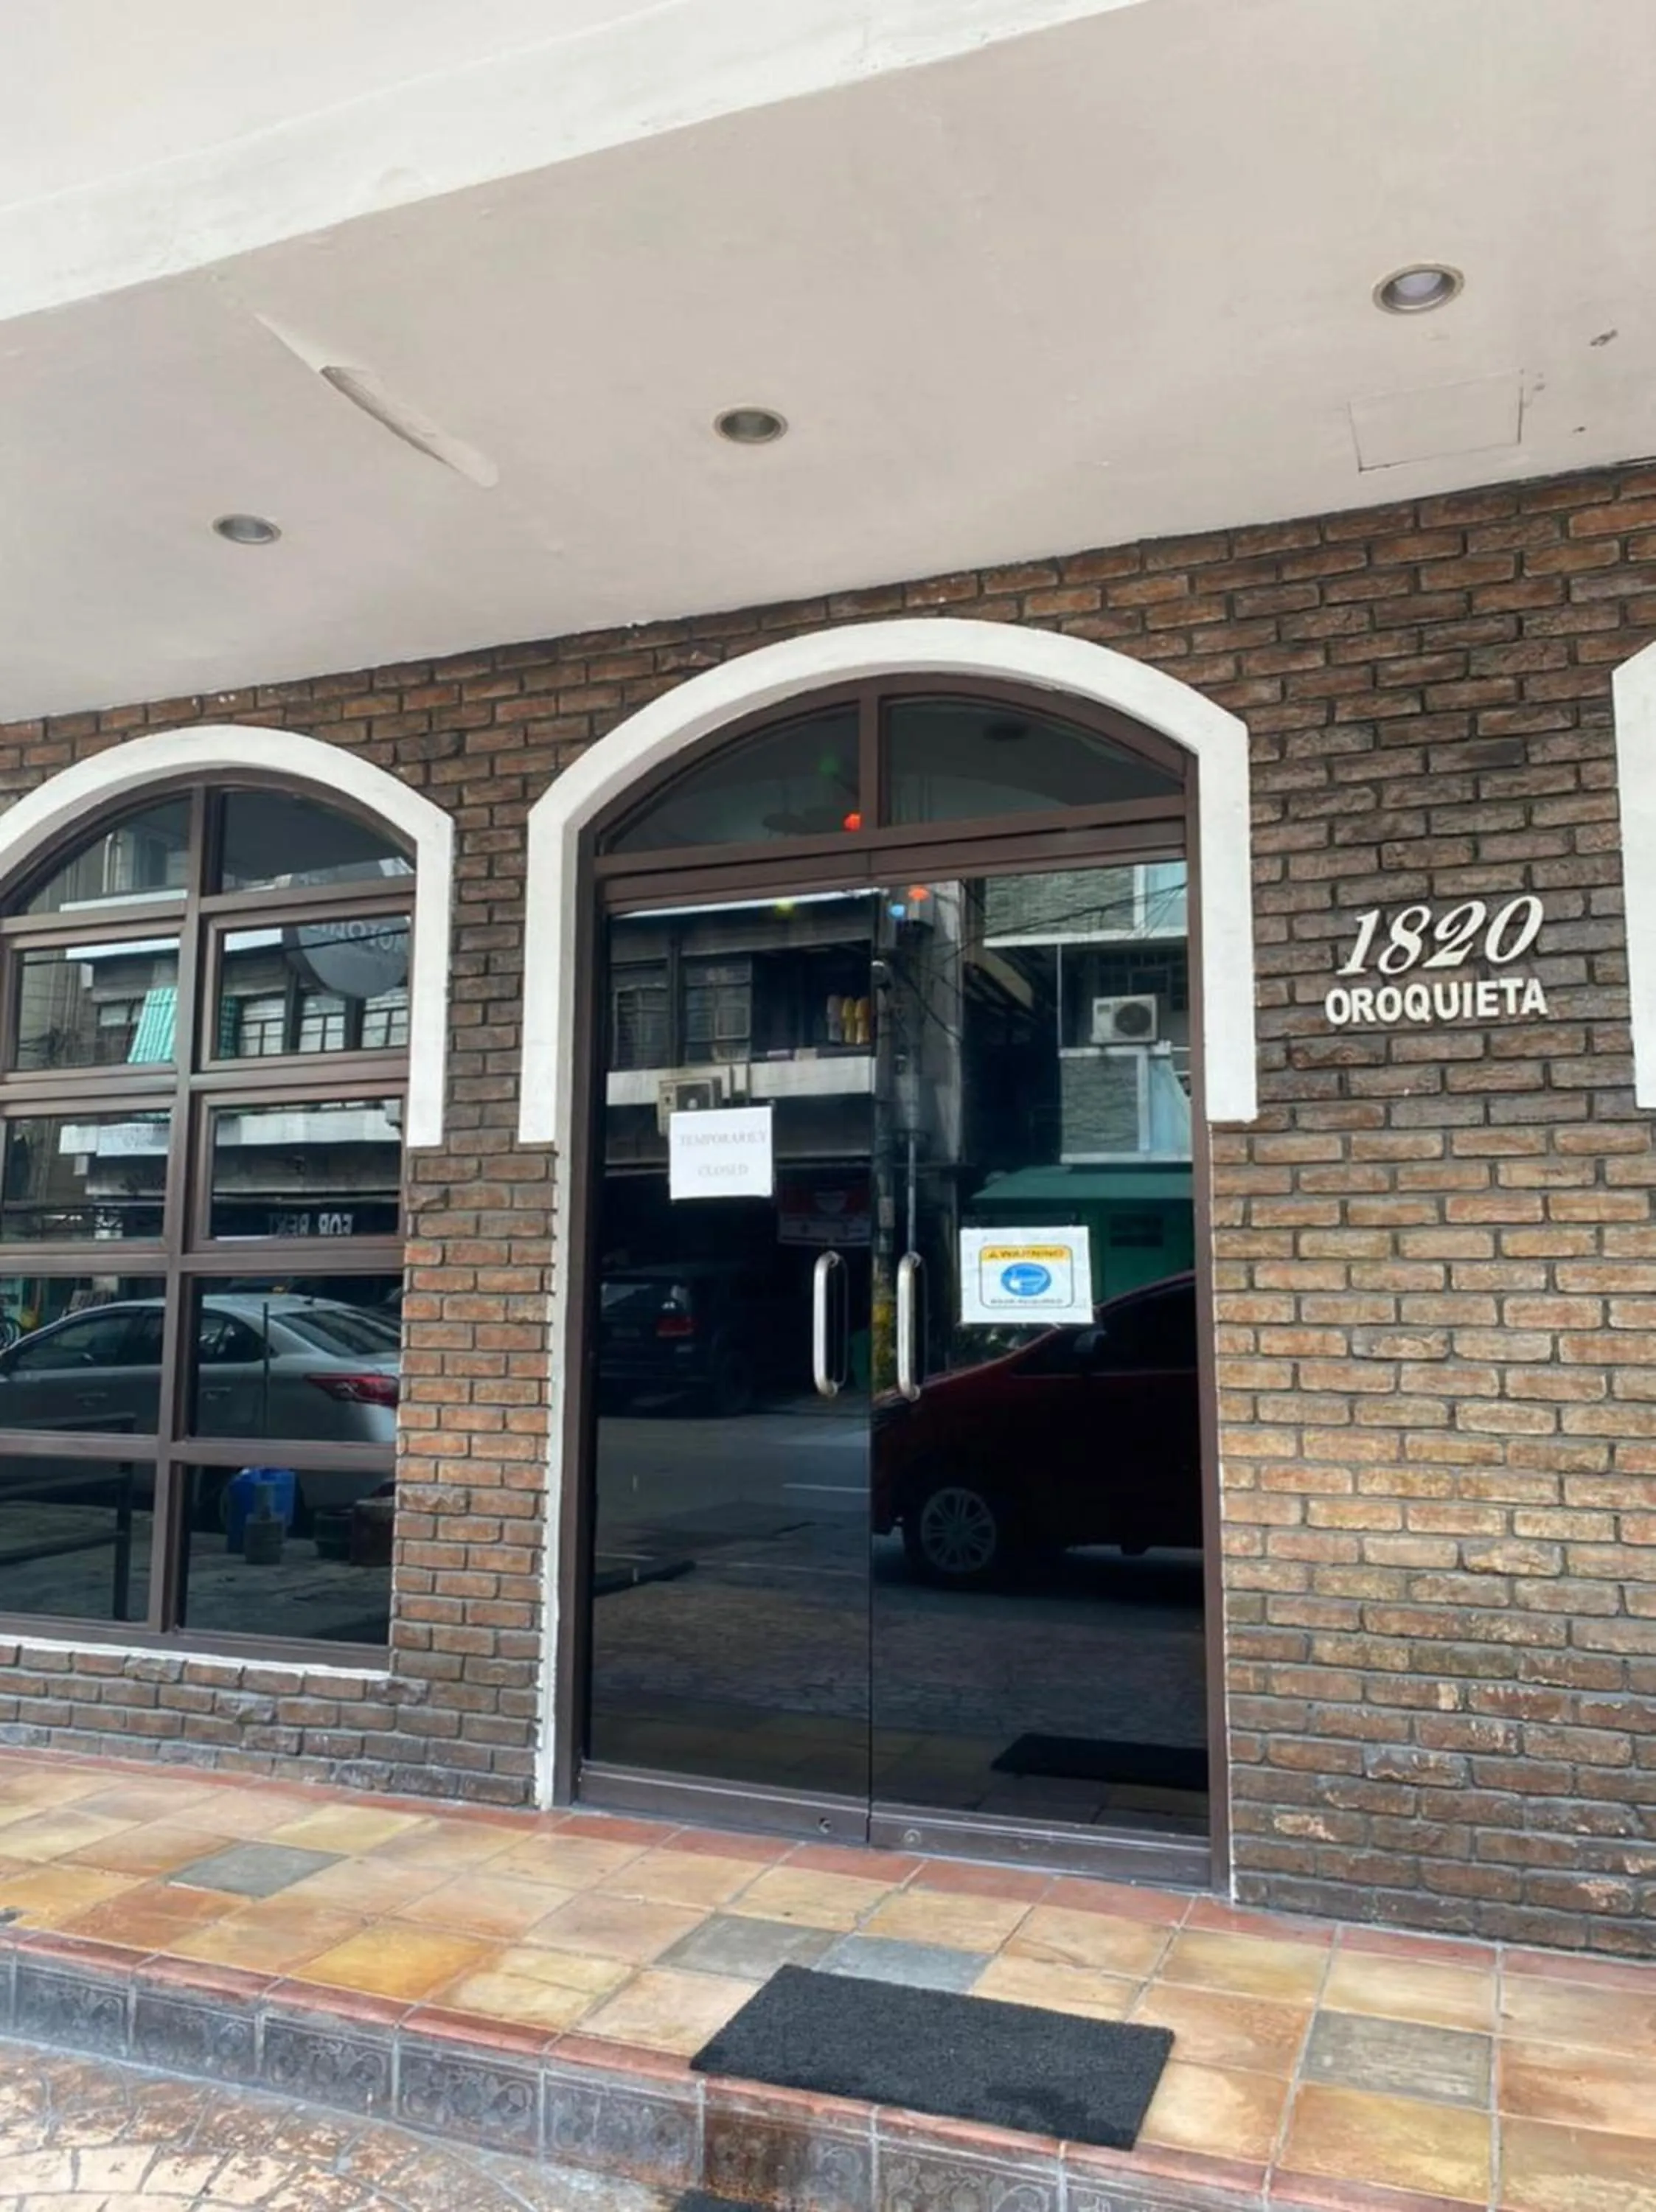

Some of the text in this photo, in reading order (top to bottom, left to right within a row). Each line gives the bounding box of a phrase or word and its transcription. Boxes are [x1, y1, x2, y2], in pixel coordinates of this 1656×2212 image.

[1335, 895, 1545, 975] 1820
[1325, 977, 1548, 1025] OROQUIETA
[697, 1162, 750, 1178] CLOSED
